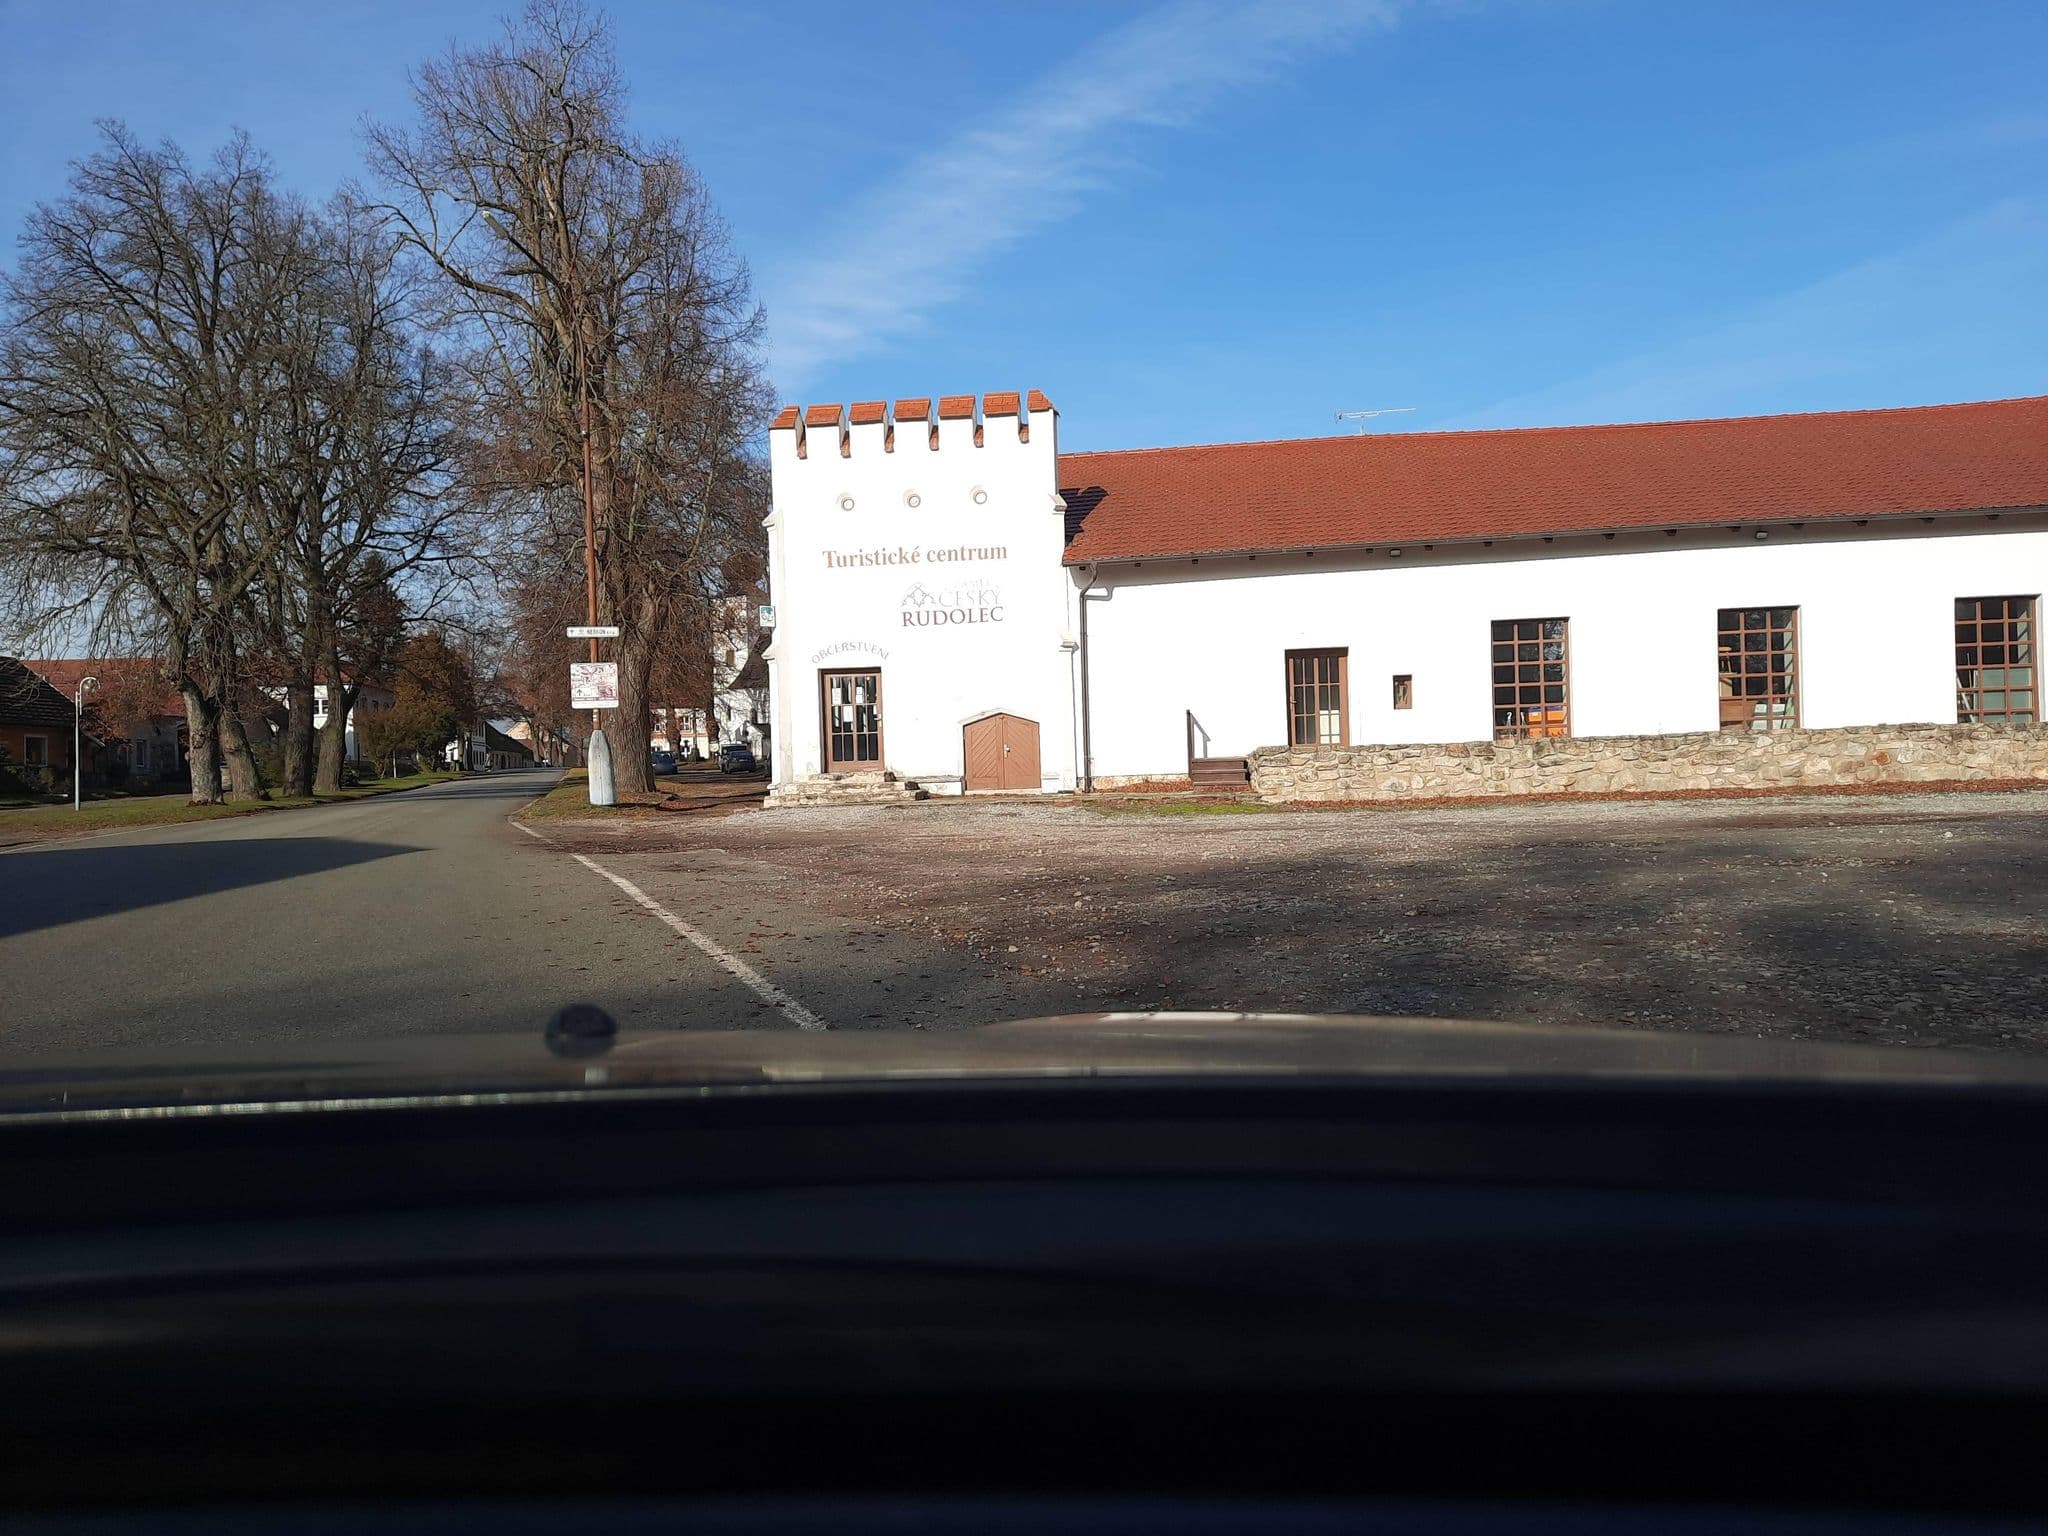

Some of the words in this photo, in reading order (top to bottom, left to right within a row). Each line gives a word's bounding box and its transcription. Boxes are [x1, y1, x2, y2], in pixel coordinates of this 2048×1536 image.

[822, 546, 921, 568] Turistické
[927, 545, 1007, 563] centrum
[901, 606, 1004, 627] RUDOLEC
